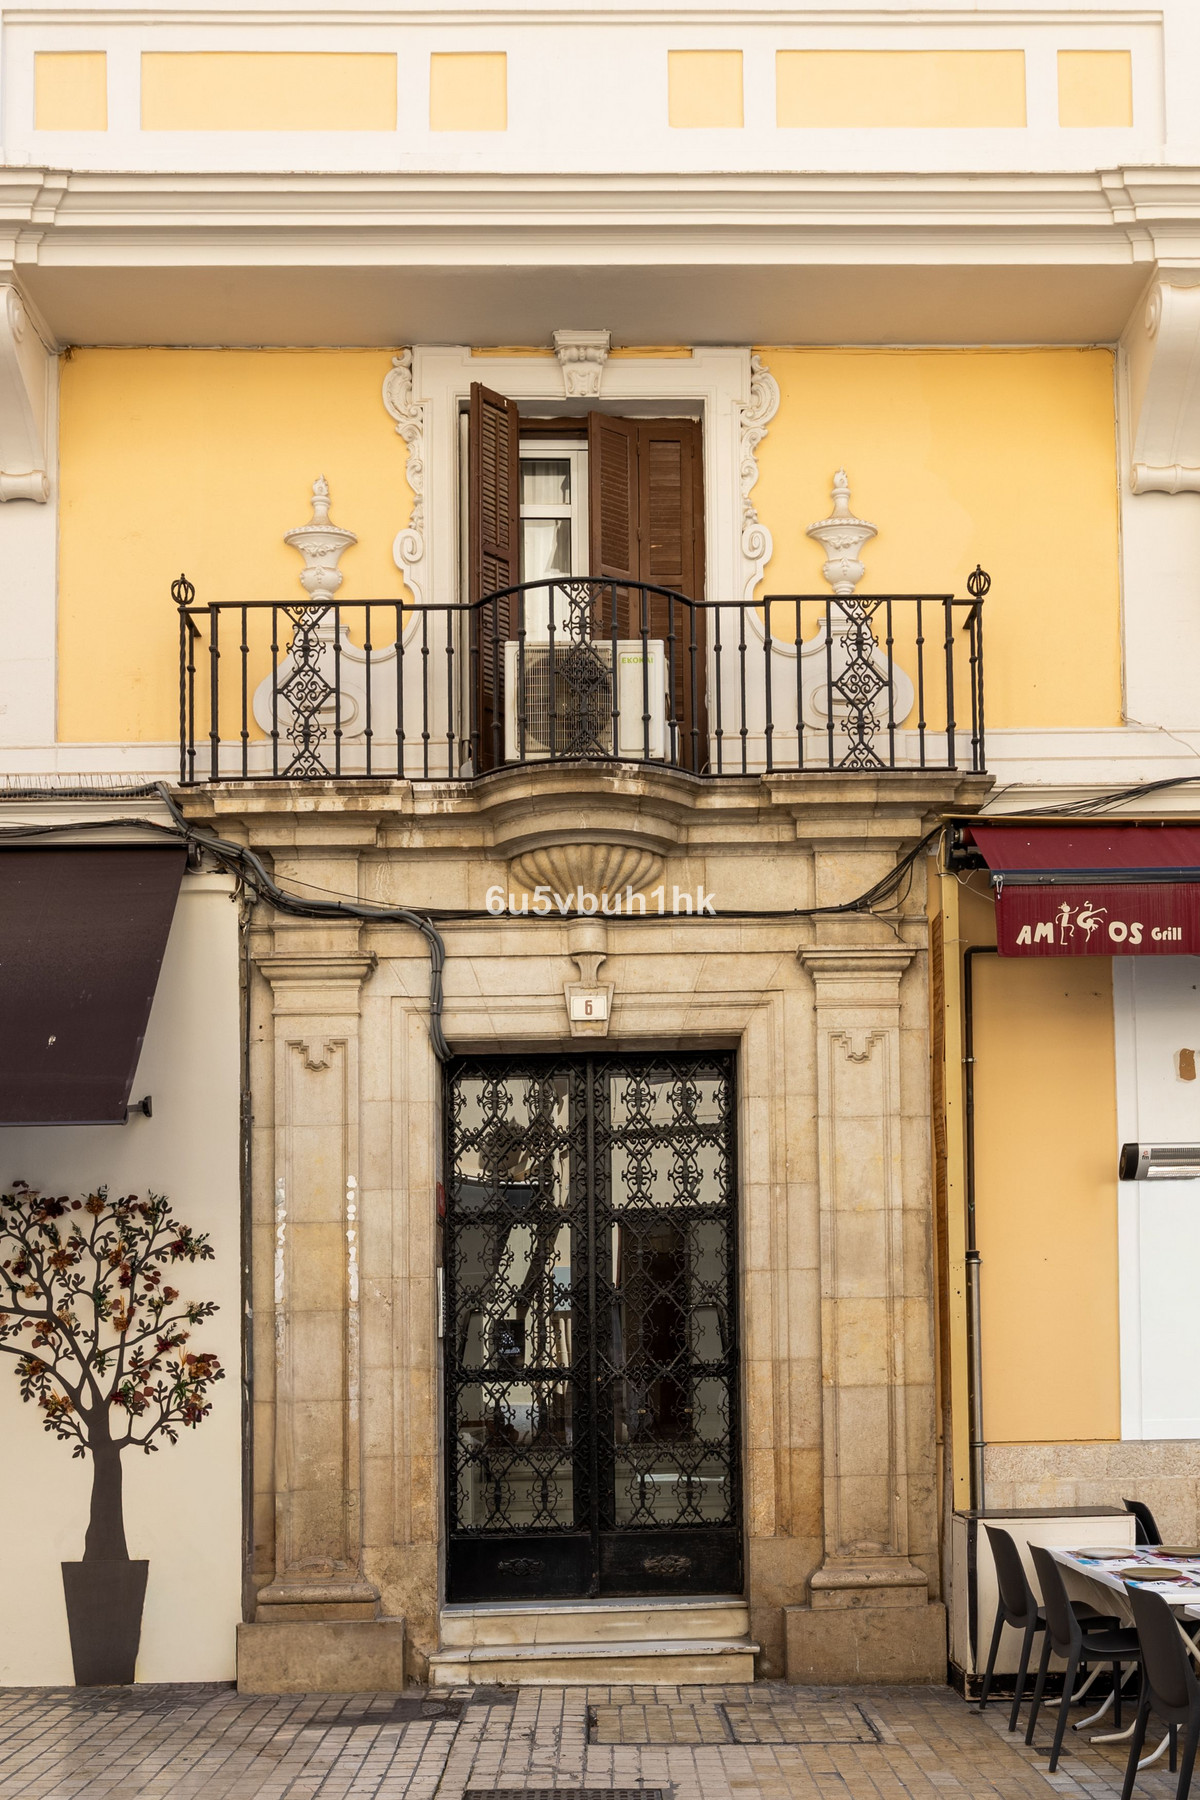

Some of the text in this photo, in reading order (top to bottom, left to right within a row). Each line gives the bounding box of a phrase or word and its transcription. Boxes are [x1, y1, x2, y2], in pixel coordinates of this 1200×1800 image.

[1015, 900, 1182, 946] AMIGOS Grill
[584, 1000, 593, 1015] 6
